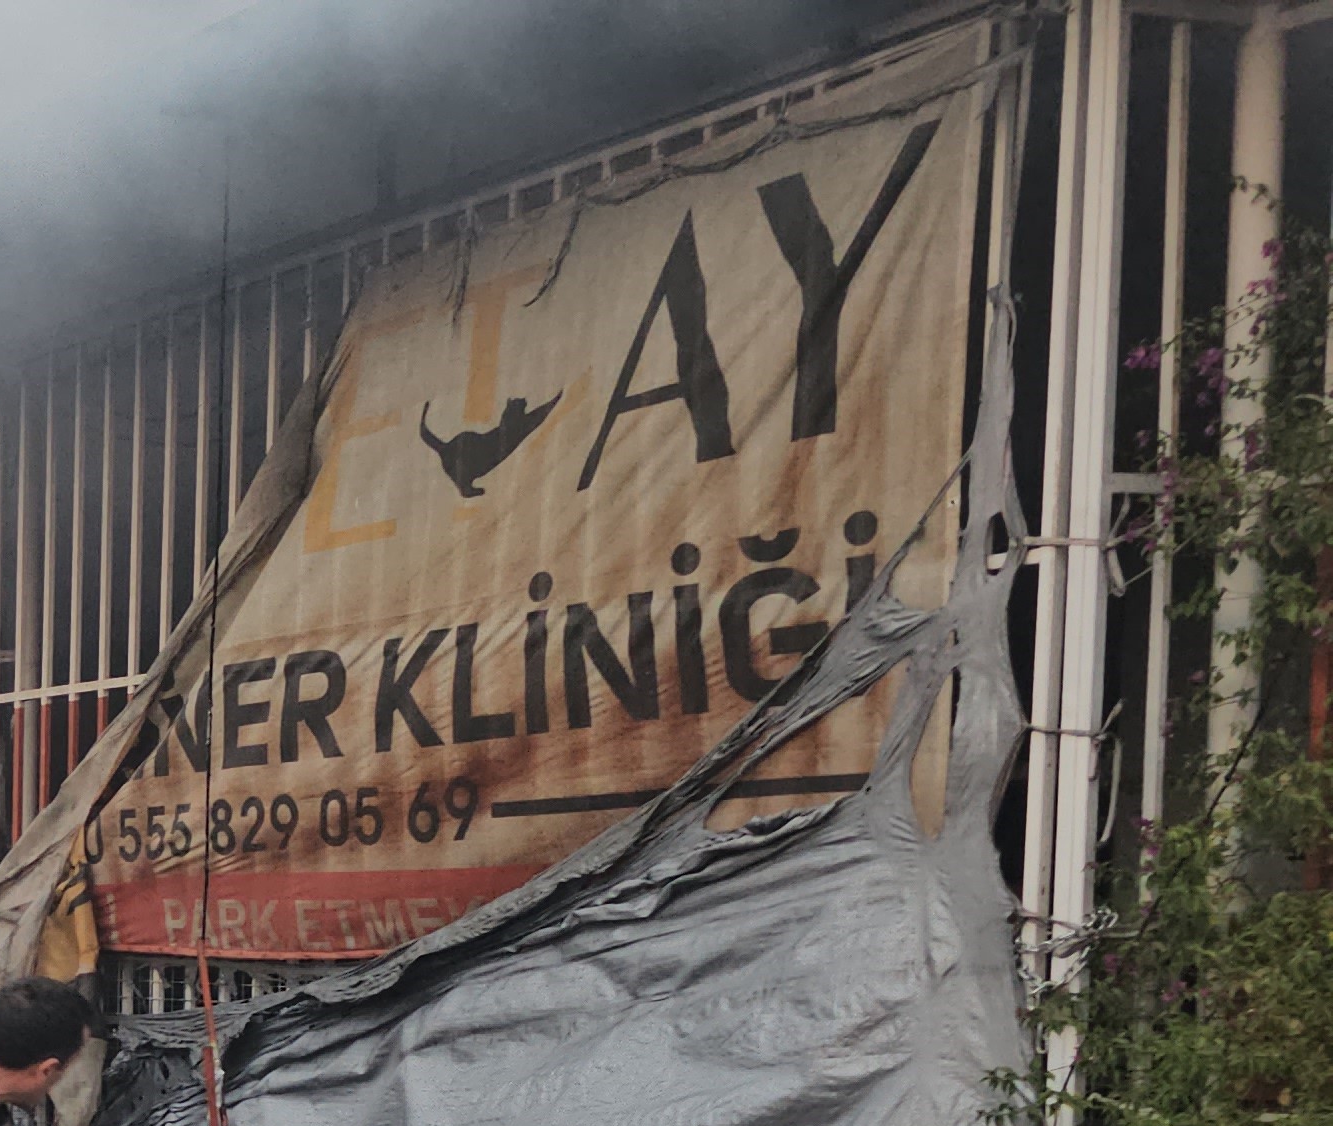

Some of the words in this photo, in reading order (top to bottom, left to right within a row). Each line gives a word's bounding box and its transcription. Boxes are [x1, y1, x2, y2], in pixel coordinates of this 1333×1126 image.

[118, 803, 192, 862] 555
[210, 793, 299, 855] 829
[319, 787, 384, 847] 05
[407, 775, 479, 842] 69
[163, 898, 280, 952] PARK
